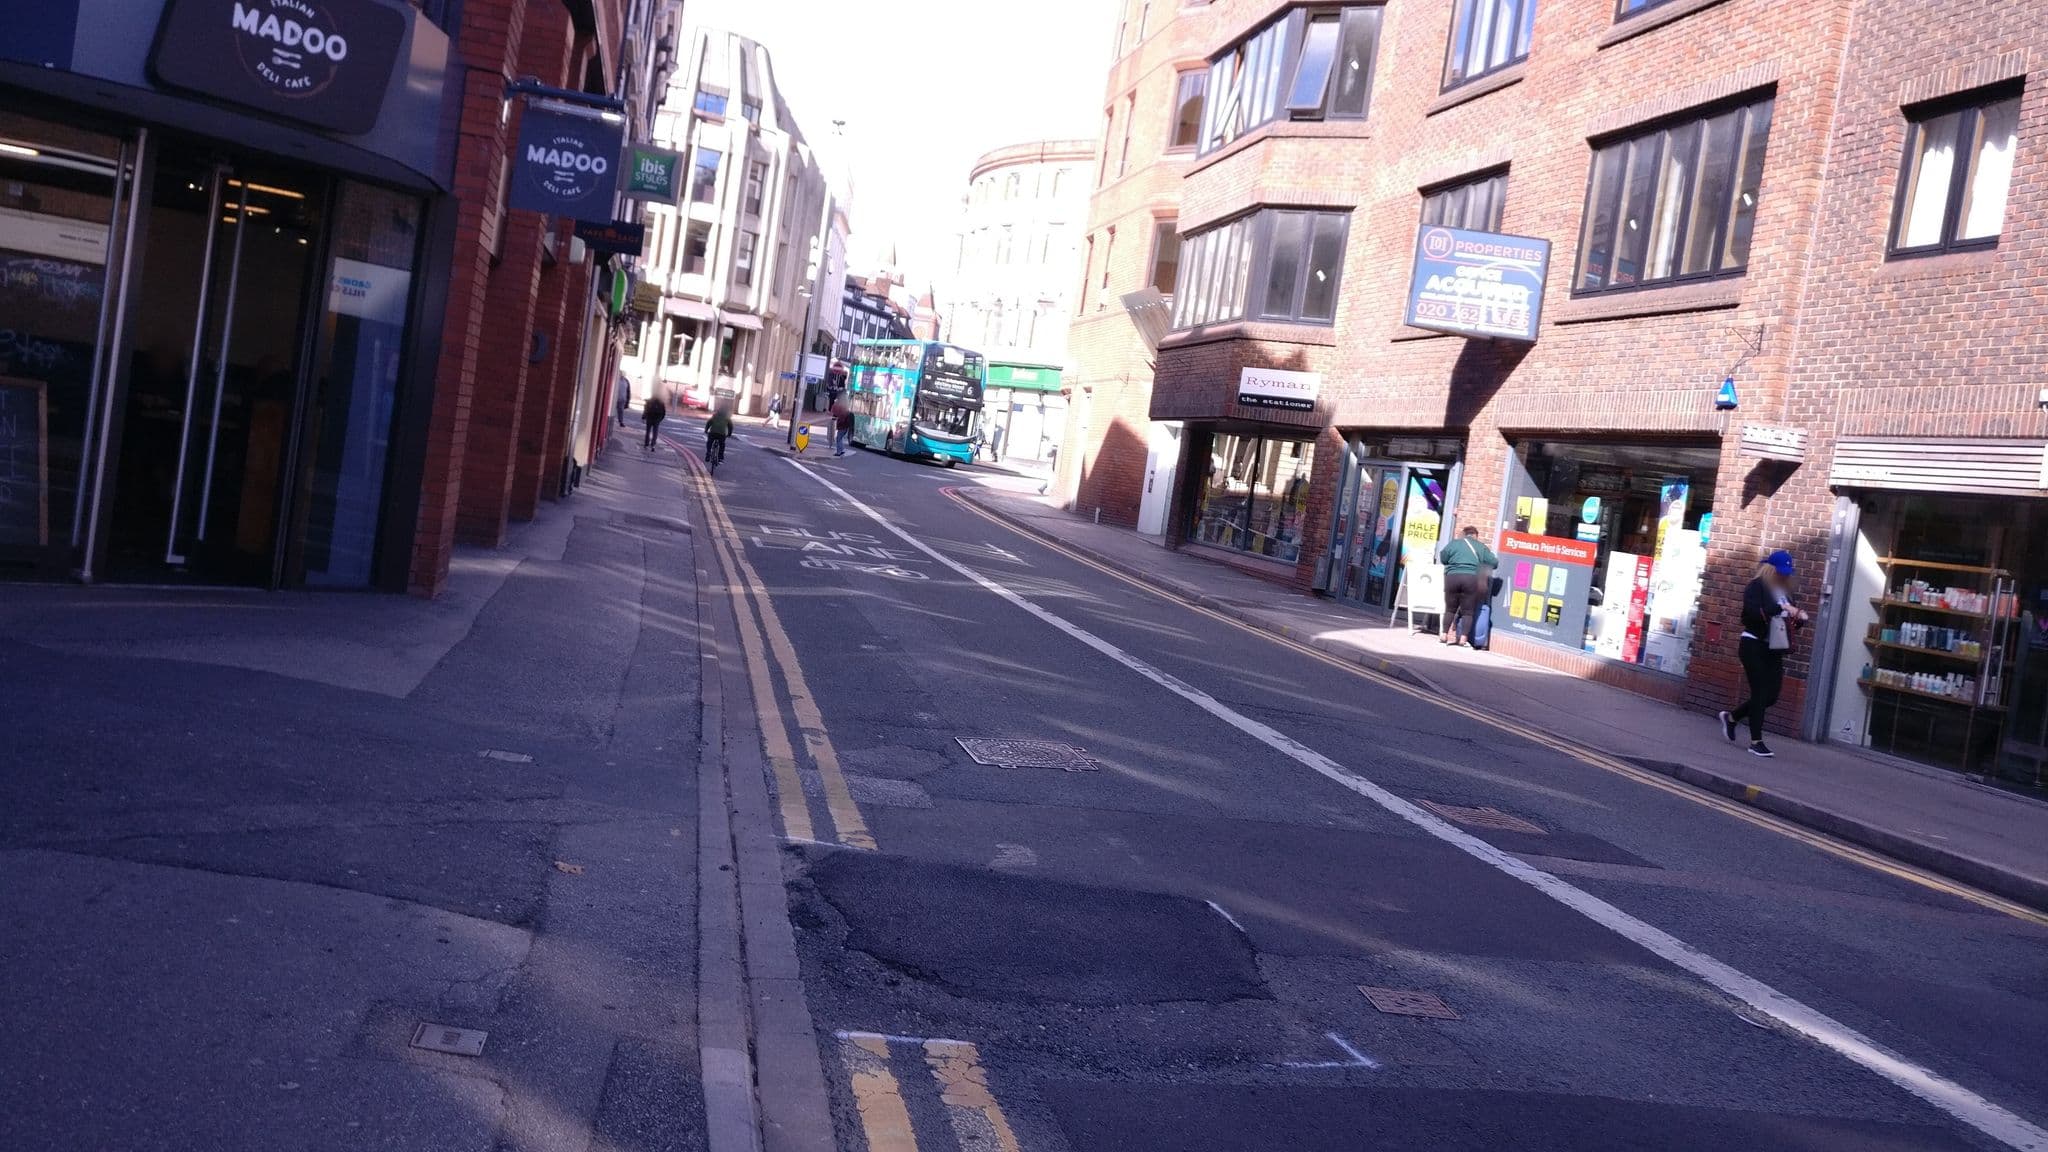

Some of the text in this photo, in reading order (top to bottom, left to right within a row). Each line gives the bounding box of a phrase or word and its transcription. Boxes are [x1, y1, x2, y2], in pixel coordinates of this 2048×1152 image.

[270, 0, 315, 18] ITALIAN
[232, 2, 347, 61] MADOO
[256, 61, 279, 83] DELI
[553, 136, 585, 149] ITALIAN
[527, 143, 607, 175] MADOO
[641, 158, 666, 176] ibis
[543, 180, 559, 194] DELI
[1455, 240, 1543, 261] PROPERTIES
[1417, 302, 1446, 318] 020
[967, 386, 974, 396] 6
[1246, 376, 1312, 391] Ryman
[1262, 399, 1312, 409] stationer
[759, 524, 883, 545] BUS
[1407, 530, 1434, 541] PRICE
[1408, 521, 1437, 532] HALF
[751, 536, 932, 564] LANE
[1506, 537, 1540, 552] Ryman
[1561, 545, 1587, 558] Services
